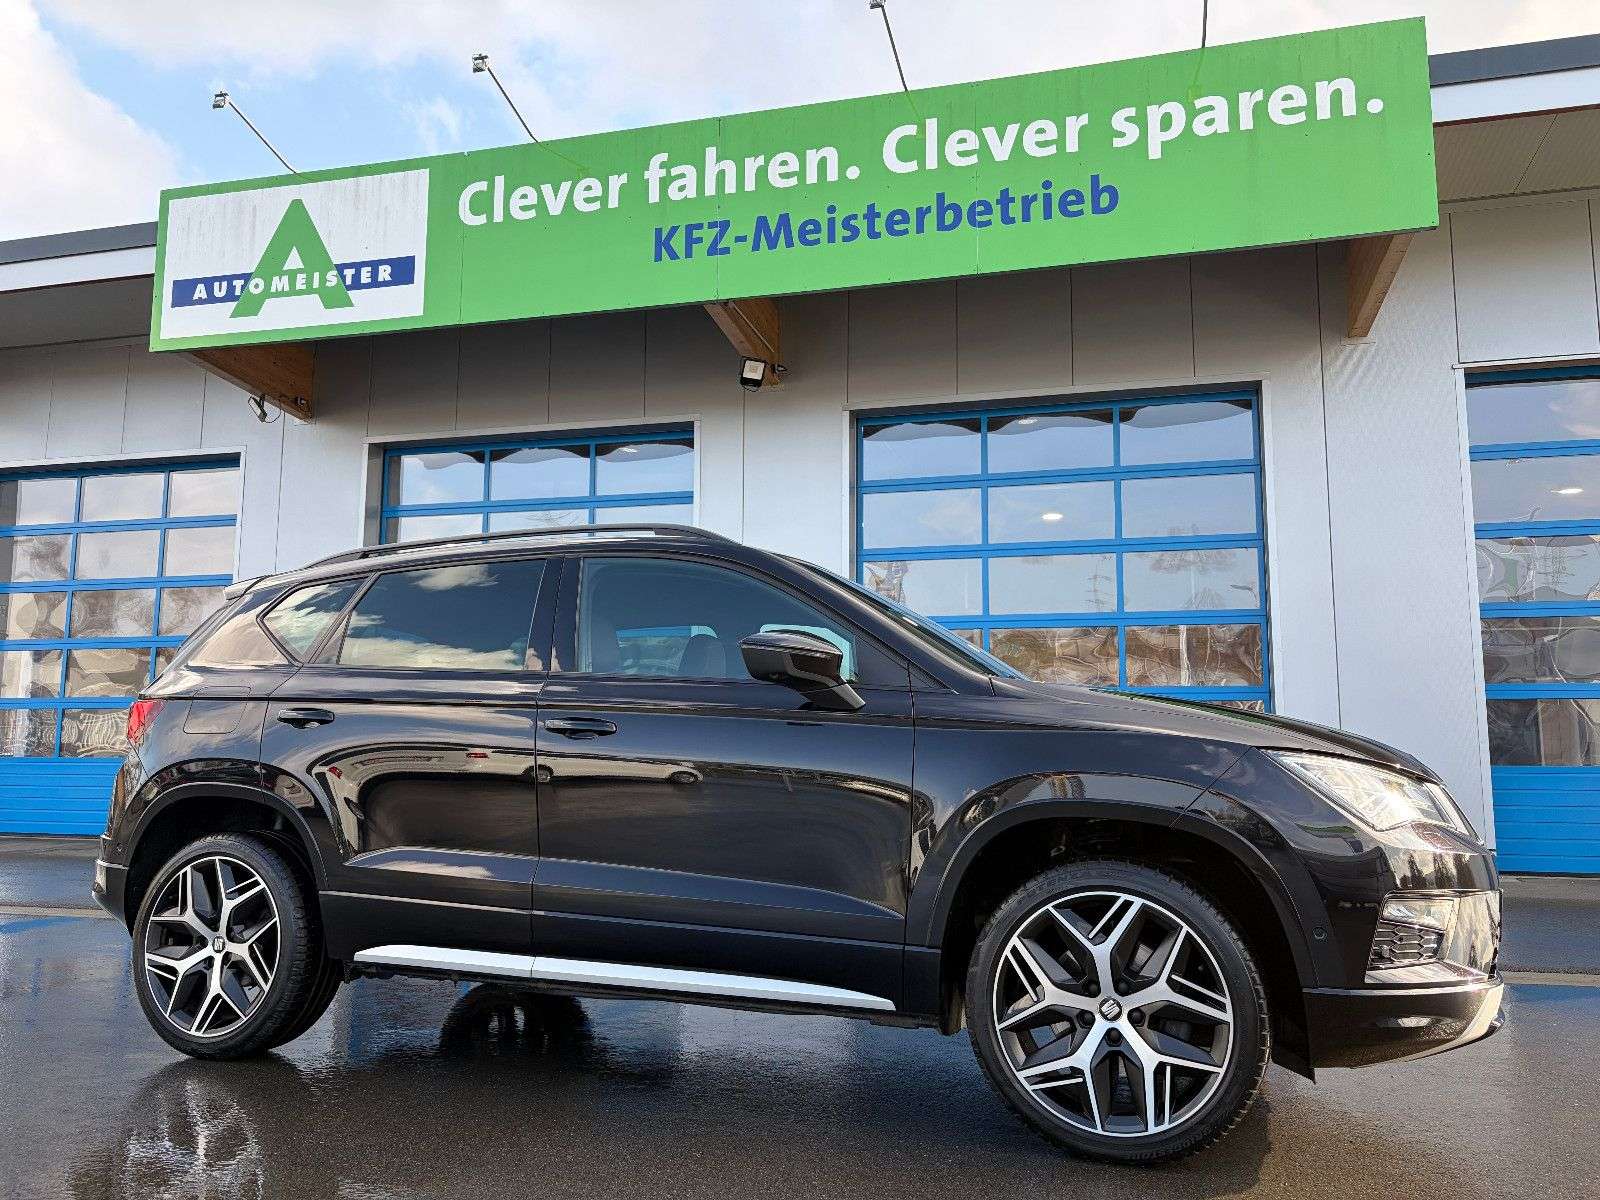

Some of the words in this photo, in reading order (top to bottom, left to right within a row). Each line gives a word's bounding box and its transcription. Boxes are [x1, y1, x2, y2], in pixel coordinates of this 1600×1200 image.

[457, 174, 629, 228] Clever
[642, 146, 862, 205] fahren.
[881, 116, 1090, 176] Clever
[1109, 77, 1386, 161] sparen.
[229, 198, 354, 319] A
[653, 174, 1120, 263] KFZ-Meisterbetrieb
[192, 264, 393, 301] AUTOMEISTER
